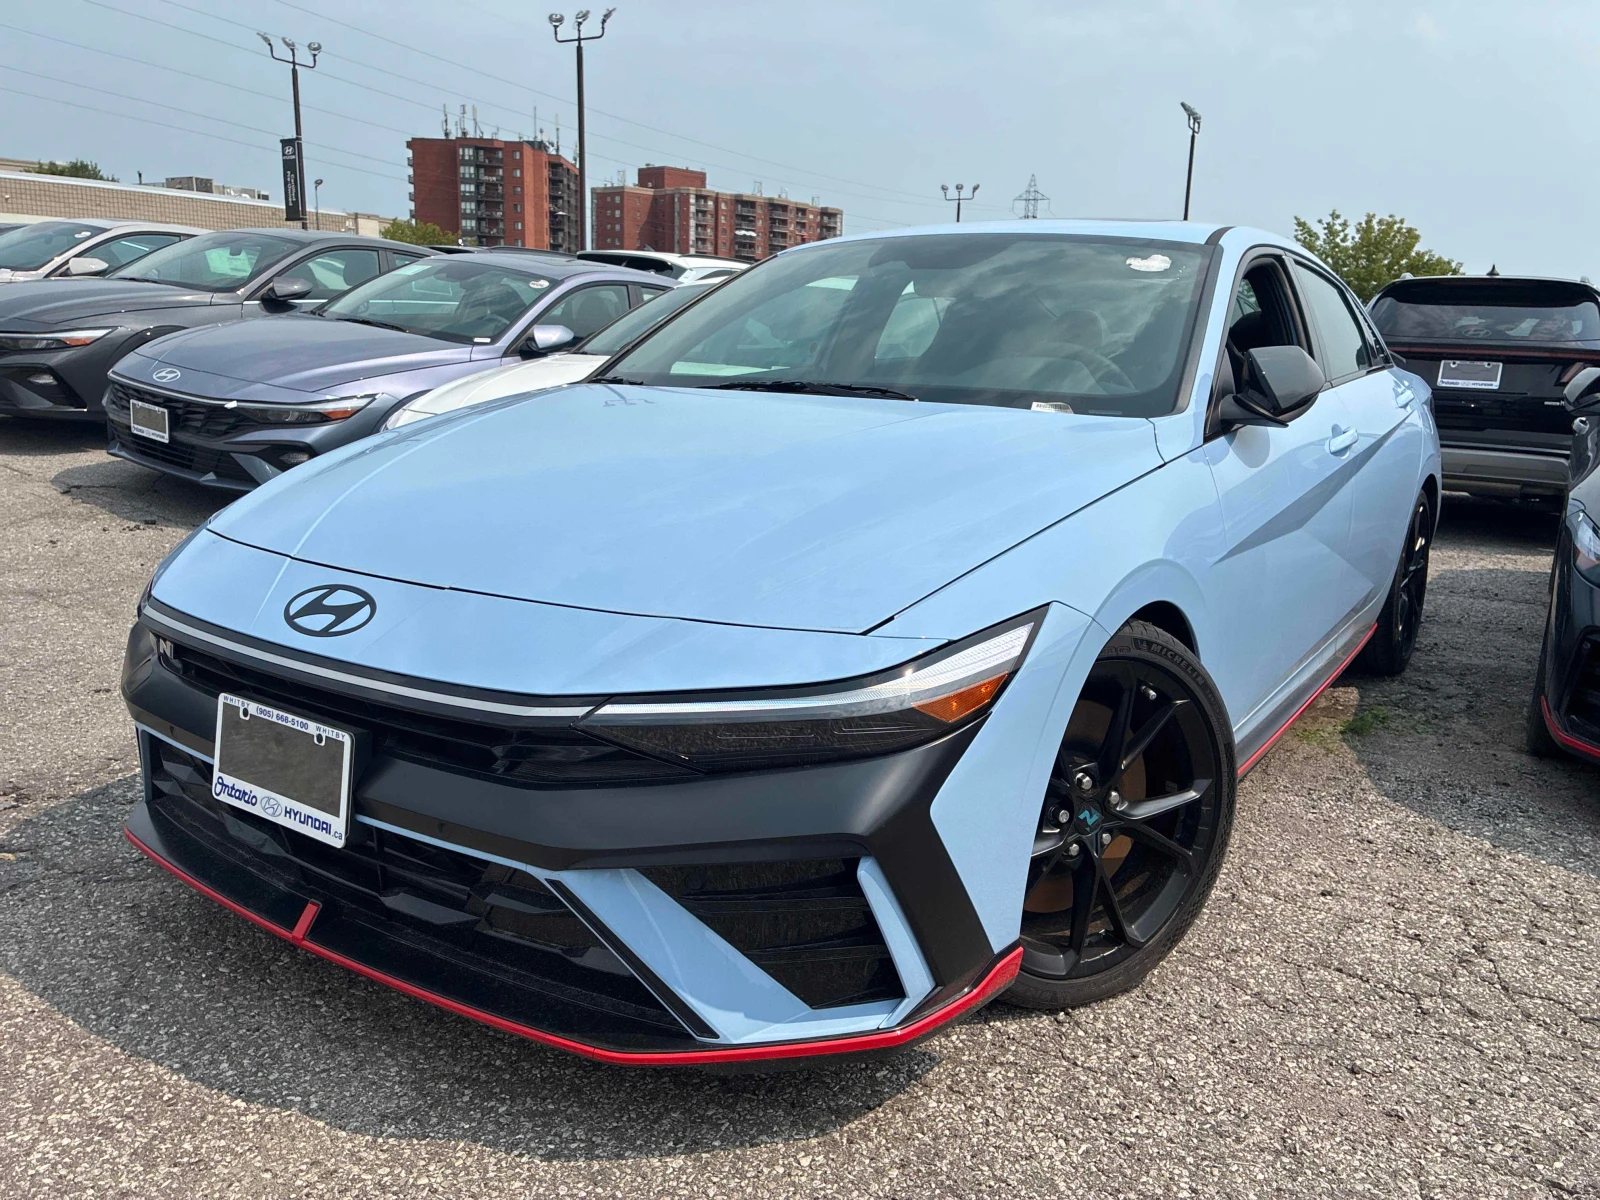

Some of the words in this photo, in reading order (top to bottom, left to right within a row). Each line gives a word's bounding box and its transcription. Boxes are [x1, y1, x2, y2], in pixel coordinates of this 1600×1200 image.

[1150, 643, 1205, 686] MICHELIN
[223, 695, 250, 709] WHITBY
[256, 705, 274, 719] (905)
[275, 713, 309, 731] 668-5100
[315, 725, 346, 741] WHITBY
[213, 776, 258, 806] Ontario
